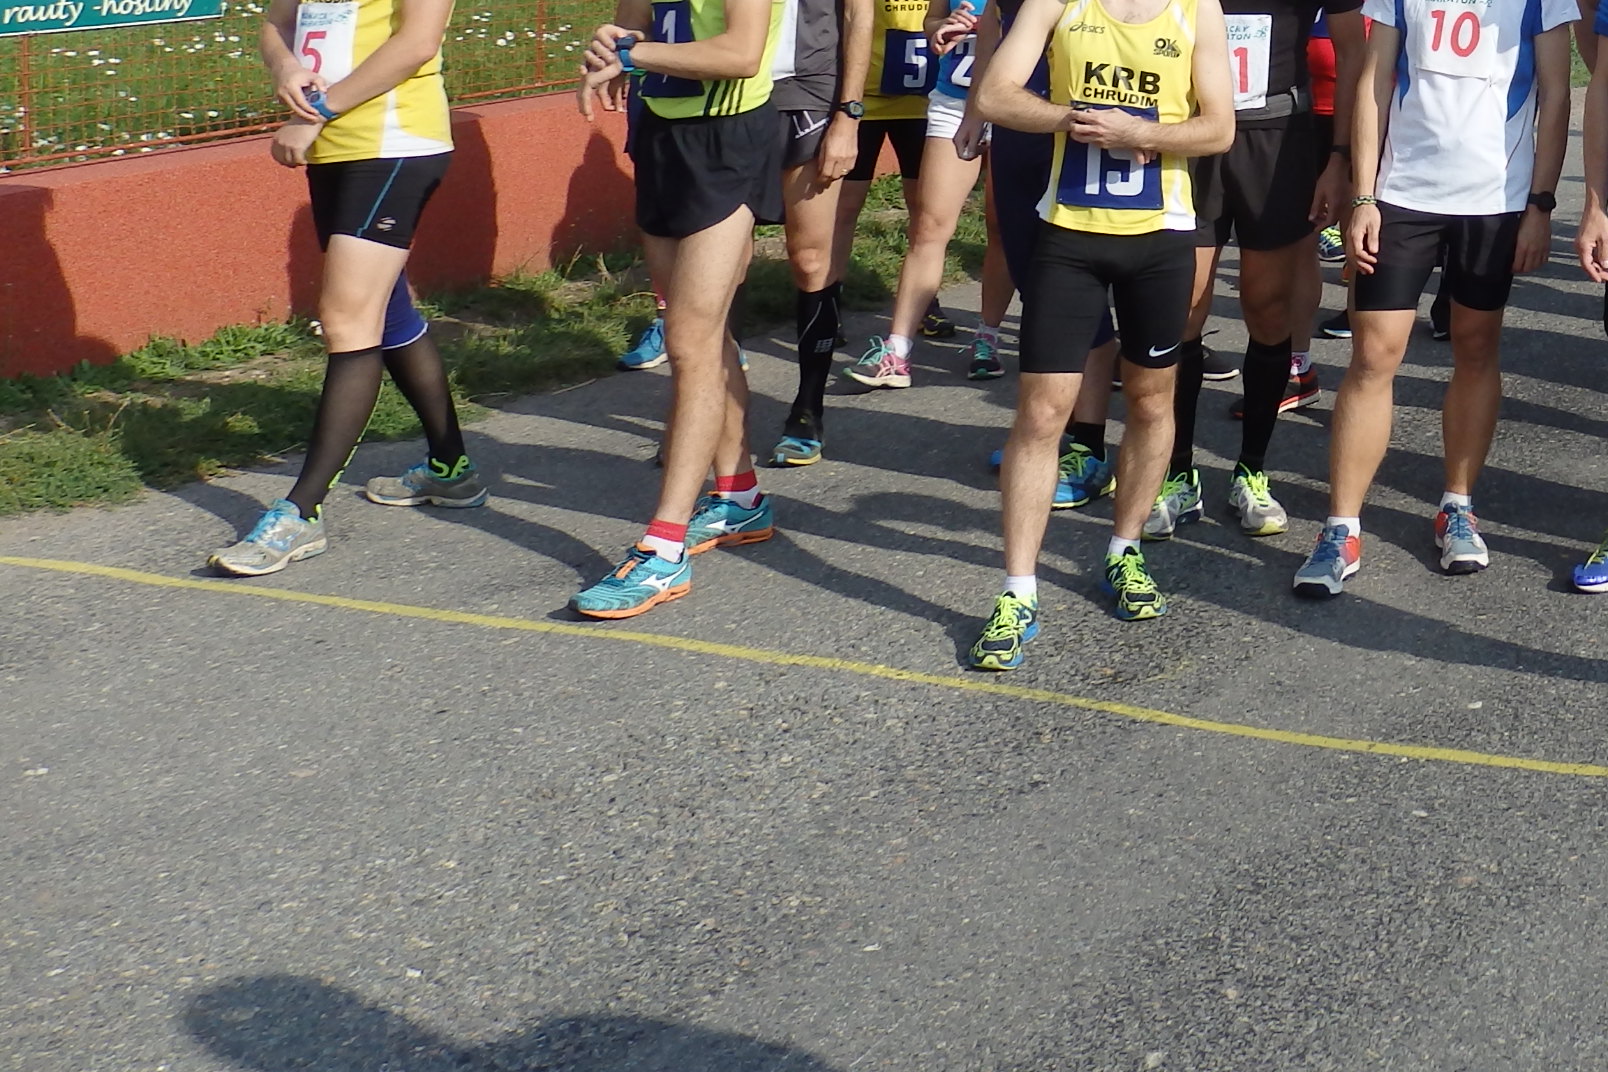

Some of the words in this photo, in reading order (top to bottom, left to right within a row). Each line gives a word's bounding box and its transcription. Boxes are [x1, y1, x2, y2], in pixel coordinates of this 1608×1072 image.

[302, 30, 328, 74] 5
[1431, 9, 1481, 58] 10
[903, 38, 928, 88] 5
[1084, 61, 1160, 95] KRB
[1083, 86, 1159, 108] CHRUDIM
